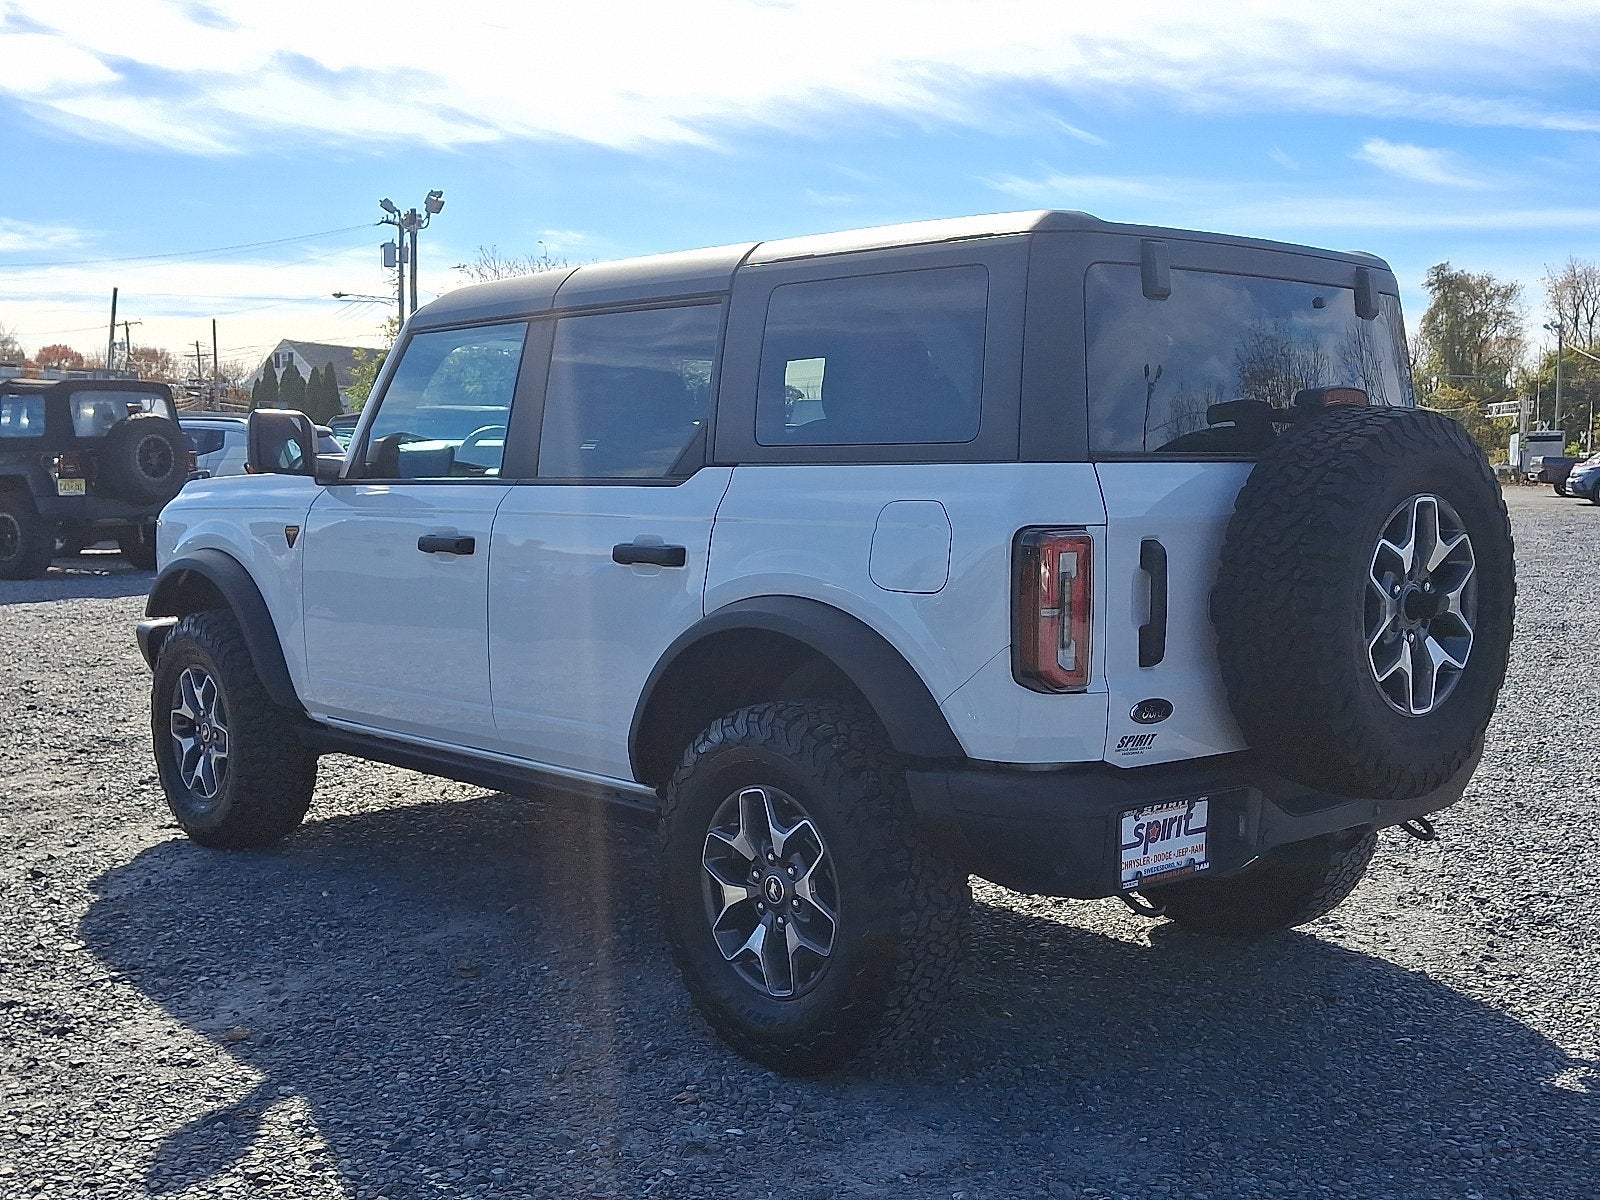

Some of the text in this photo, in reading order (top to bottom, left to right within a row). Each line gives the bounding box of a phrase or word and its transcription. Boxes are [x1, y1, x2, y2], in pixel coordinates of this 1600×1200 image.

[1142, 704, 1165, 719] Ford
[1117, 734, 1157, 748] SPIRIT
[1121, 843, 1204, 871] CHRYSLER DODGE JEEP RAM
[1195, 862, 1210, 872] RAM
